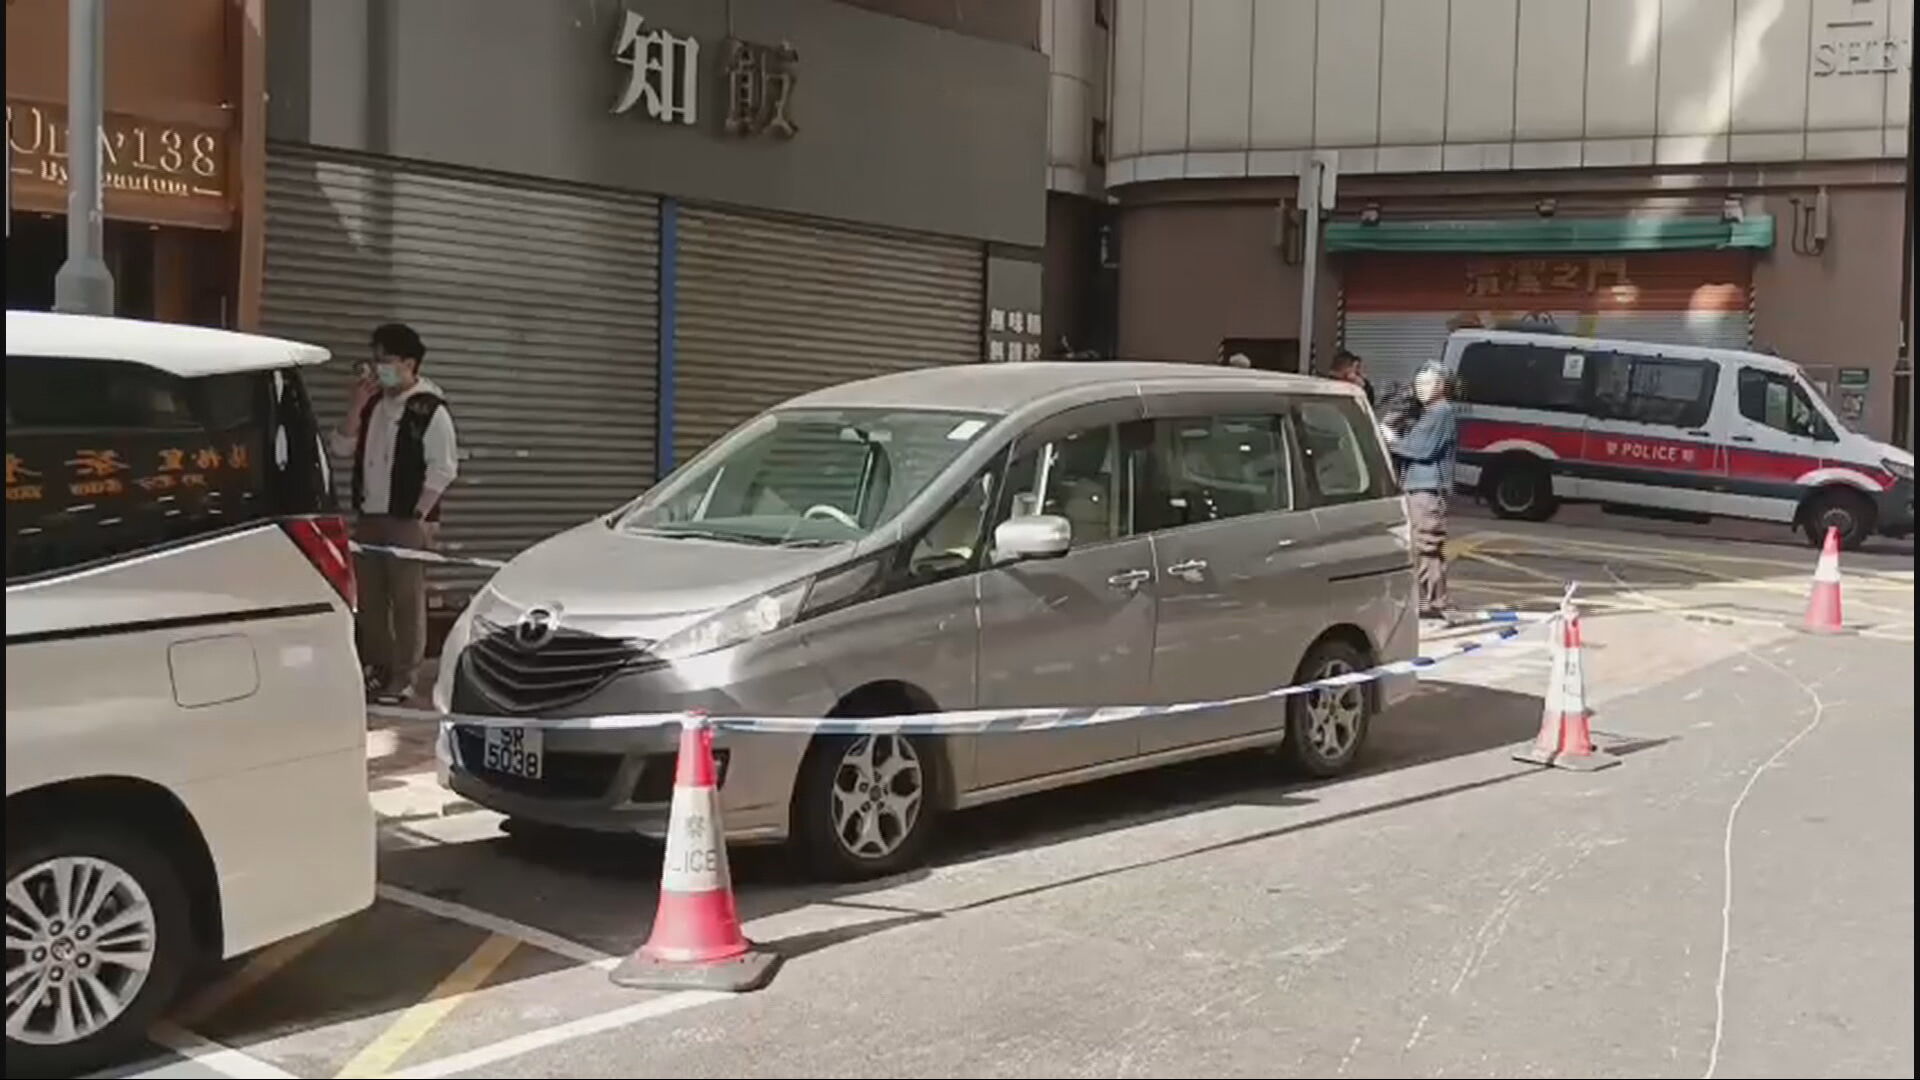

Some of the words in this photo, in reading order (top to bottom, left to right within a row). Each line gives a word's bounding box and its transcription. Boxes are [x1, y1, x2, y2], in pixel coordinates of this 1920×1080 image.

[1813, 39, 1911, 77] SHE
[1622, 442, 1679, 461] POLICE
[487, 743, 539, 776] 5038
